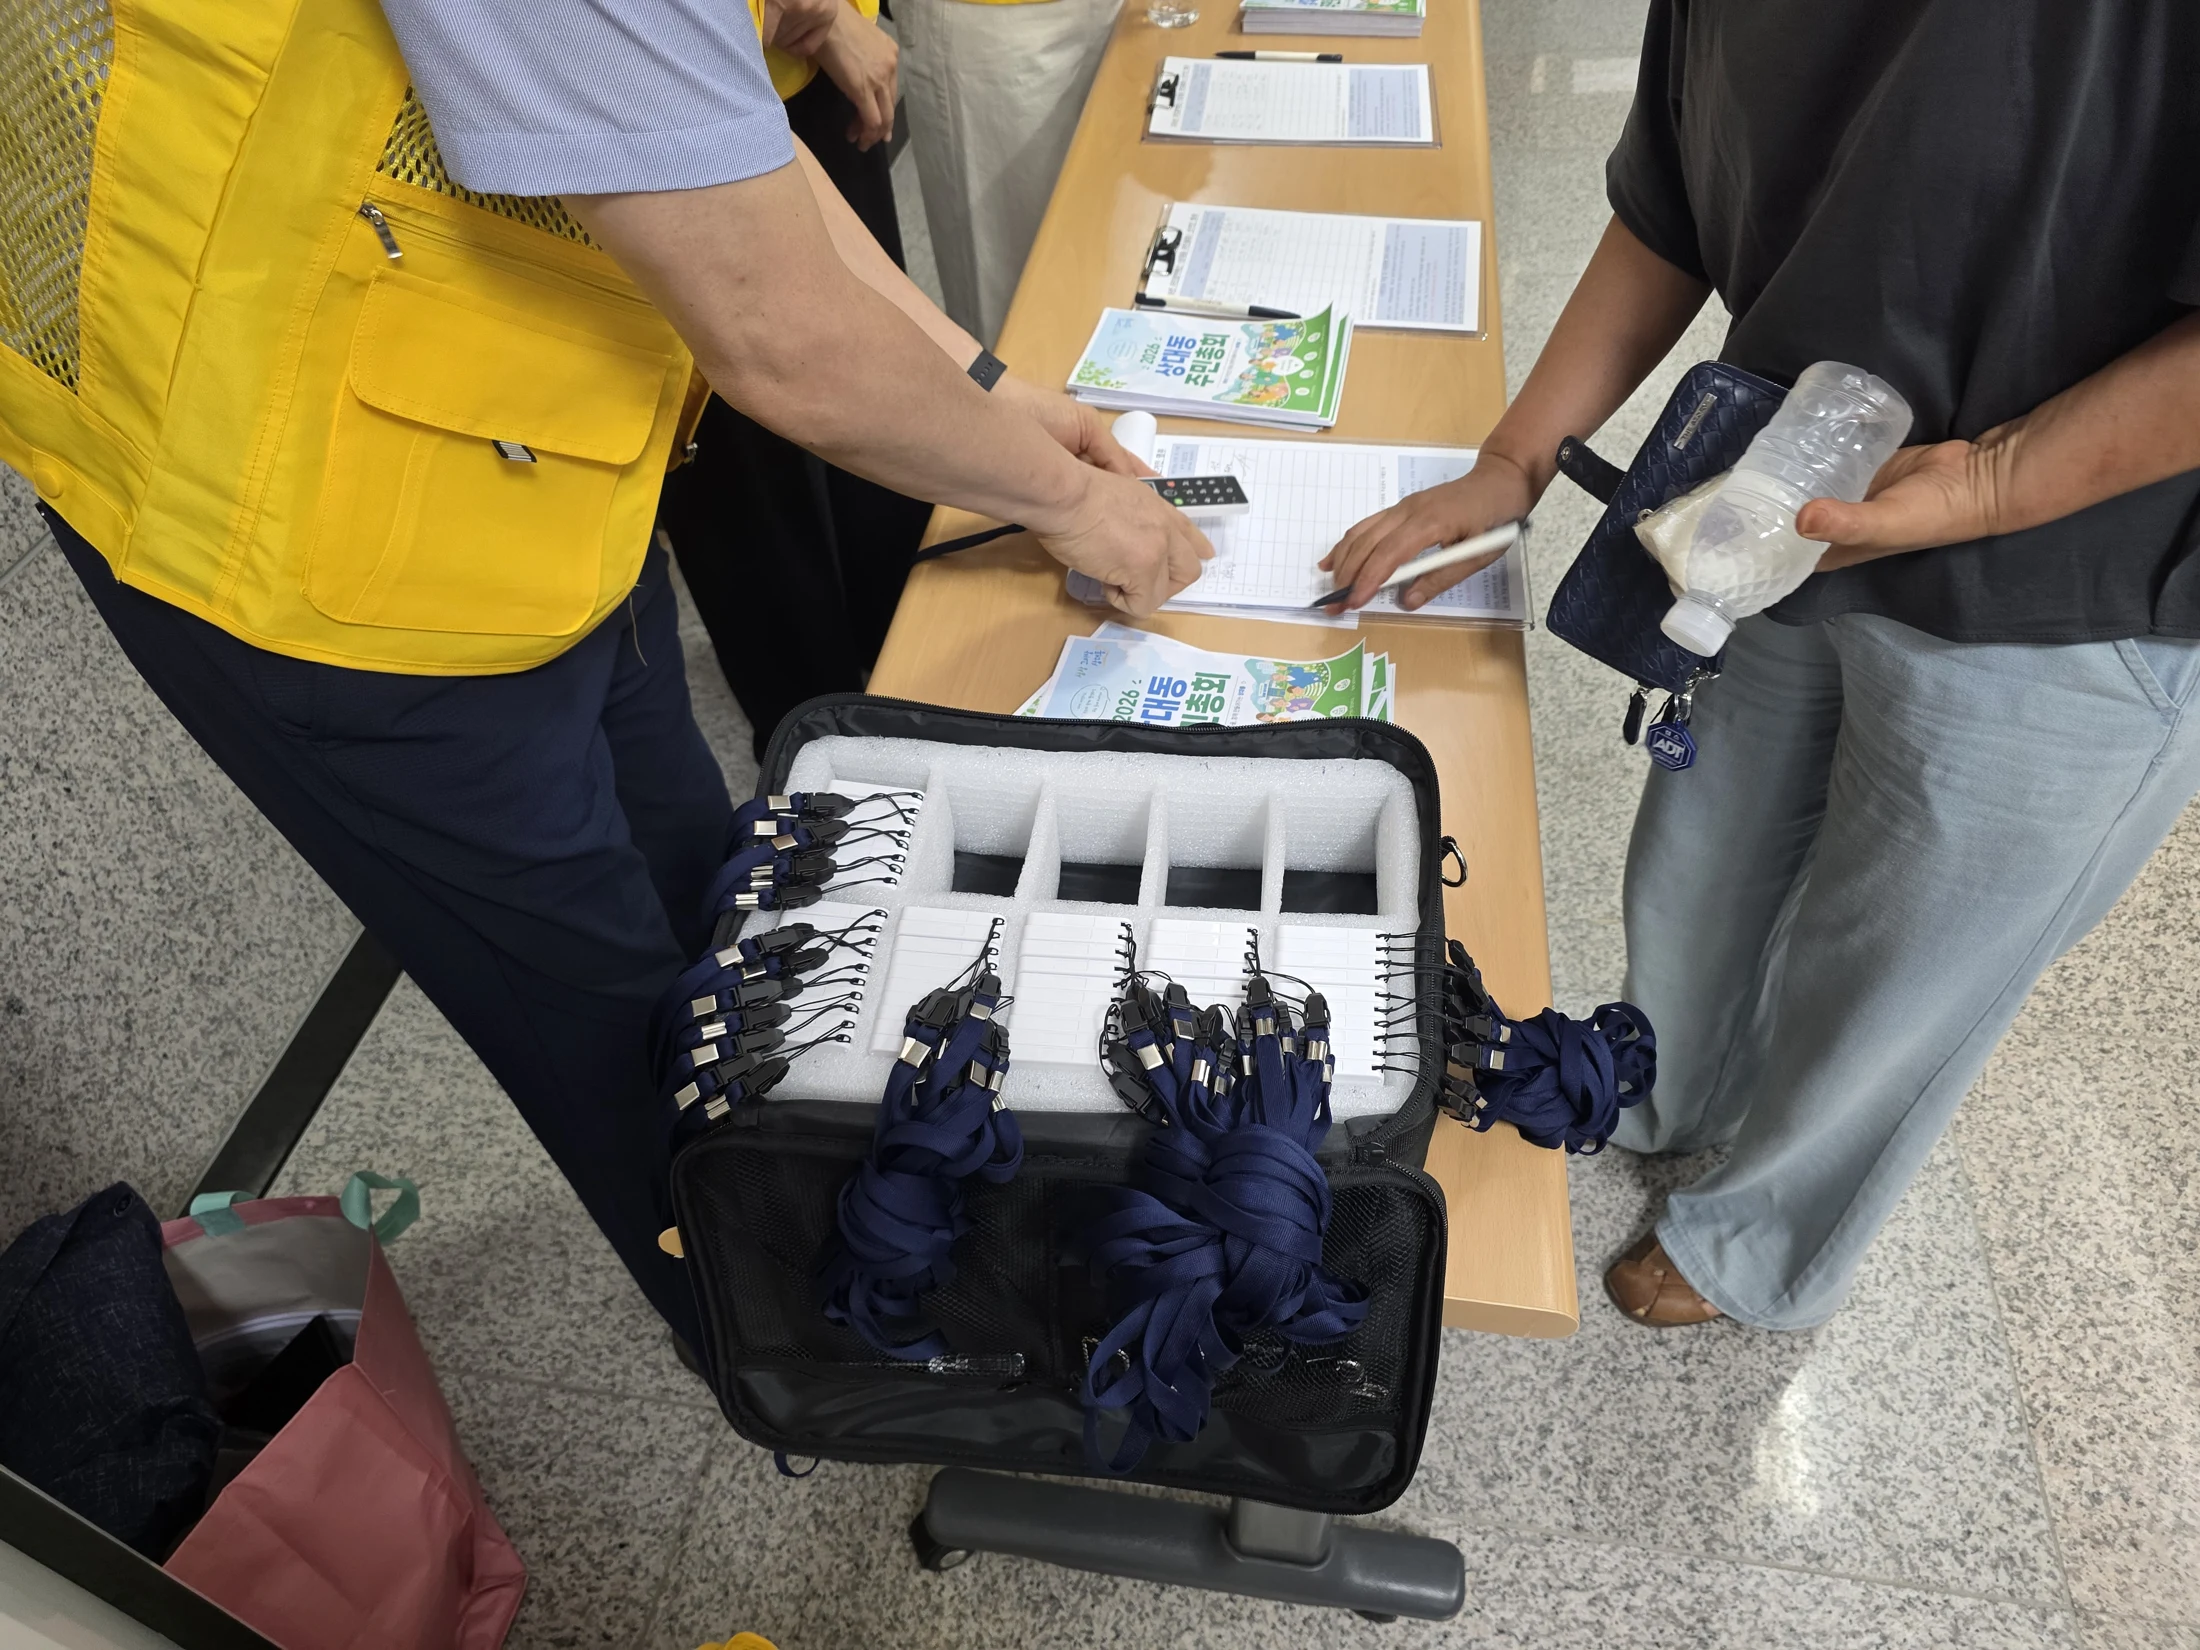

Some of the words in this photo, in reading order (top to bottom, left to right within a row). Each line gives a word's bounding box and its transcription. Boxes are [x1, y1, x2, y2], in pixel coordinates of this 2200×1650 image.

[1140, 343, 1160, 365] 2026
[1155, 335, 1197, 377] 상대동
[1184, 333, 1231, 387] 주민총회
[1113, 690, 1140, 721] 2026
[1141, 676, 1187, 724] 대동
[1653, 738, 1685, 759] ADT
